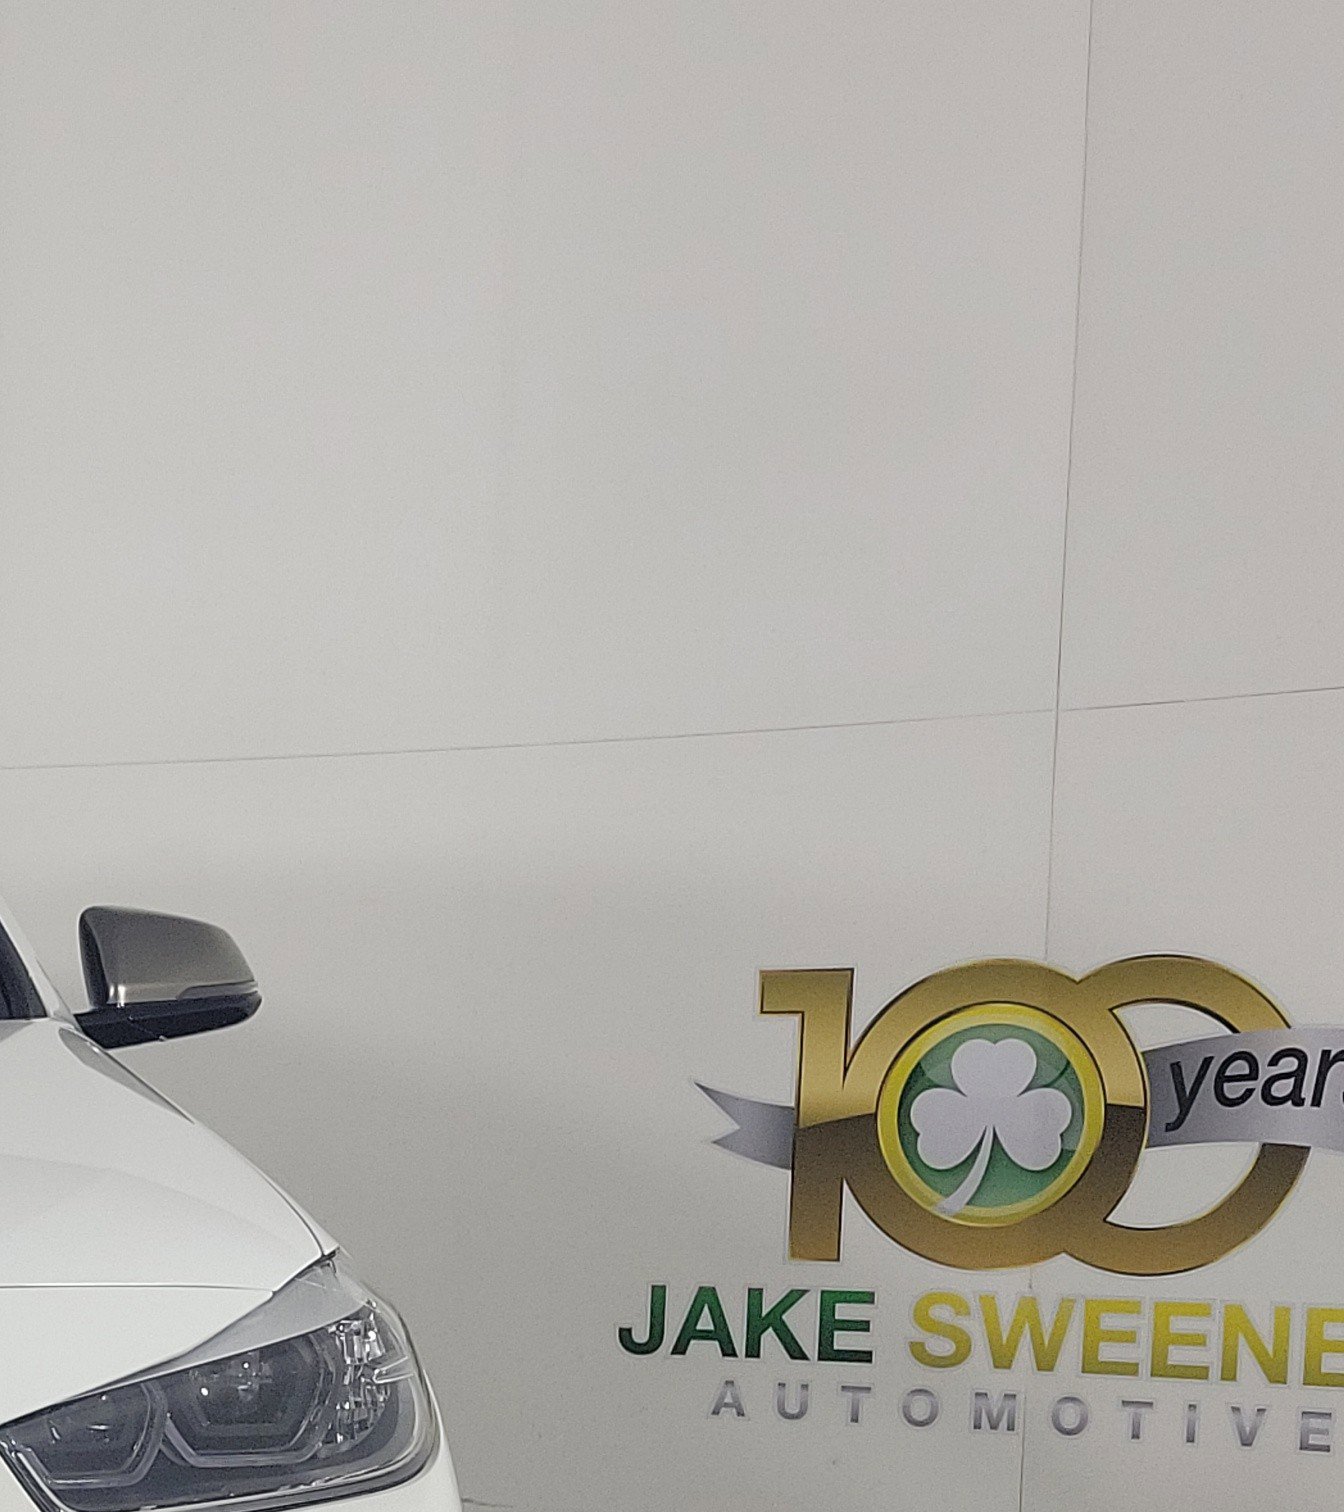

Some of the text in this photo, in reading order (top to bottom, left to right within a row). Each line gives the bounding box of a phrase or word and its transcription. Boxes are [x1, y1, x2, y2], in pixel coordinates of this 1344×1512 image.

[758, 954, 1344, 1277] 100 year
[618, 1284, 1344, 1389] JAKE SWEENE
[711, 1379, 1333, 1454] AUTOMOTIVE
